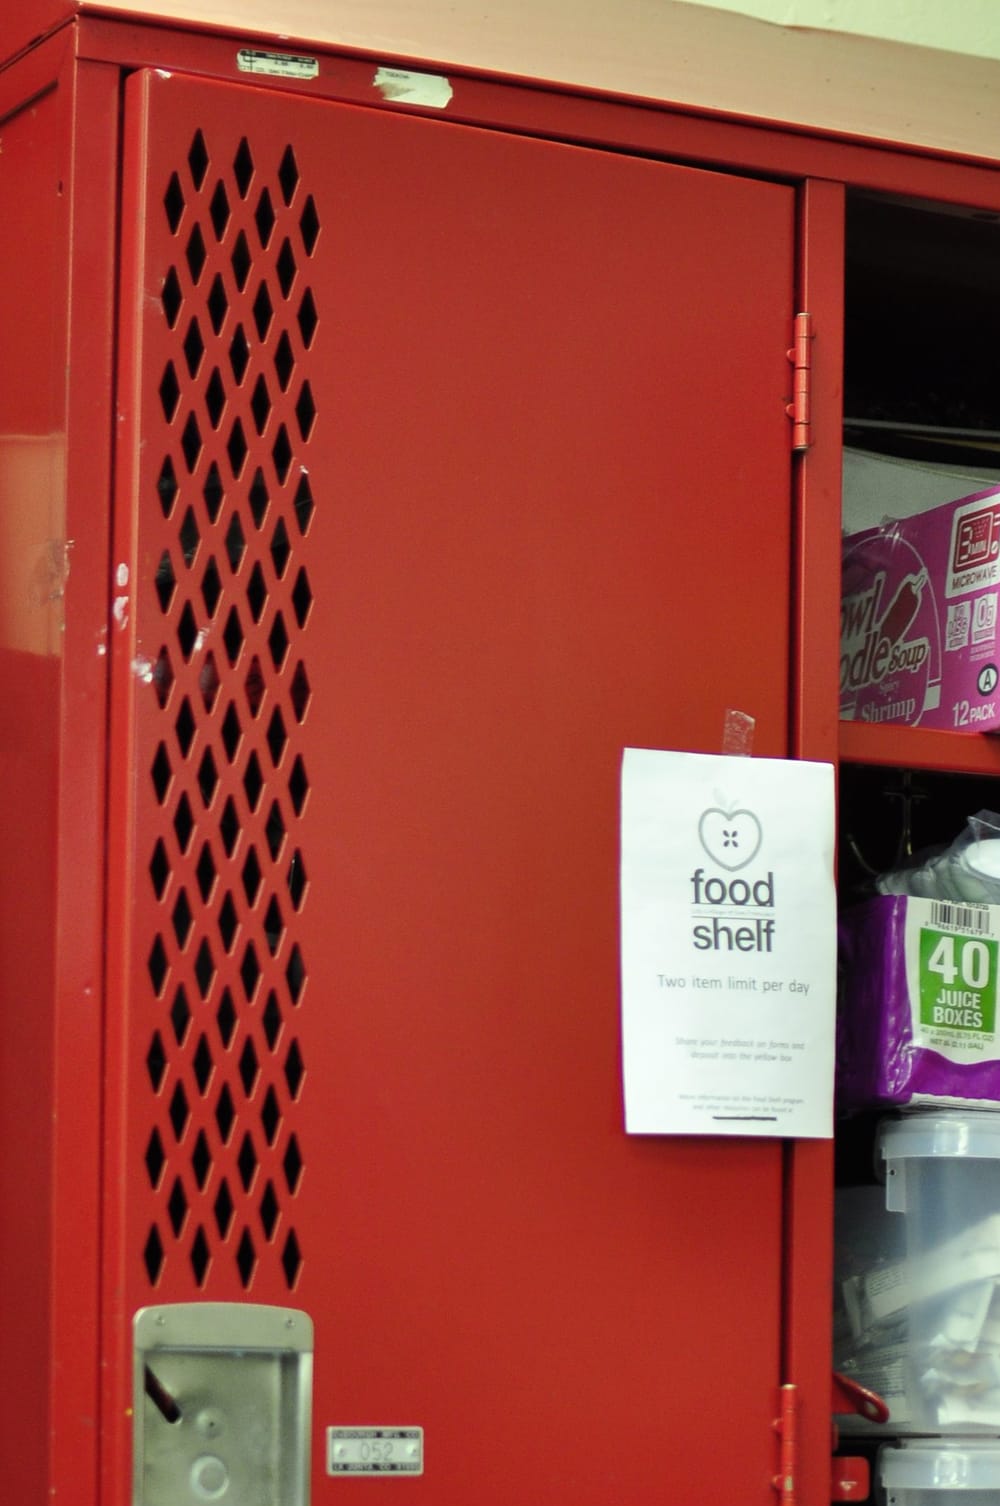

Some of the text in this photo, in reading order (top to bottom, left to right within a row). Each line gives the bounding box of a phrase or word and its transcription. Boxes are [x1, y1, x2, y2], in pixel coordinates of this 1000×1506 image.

[952, 565, 998, 590] MICROWAVE
[861, 696, 916, 723] Shrimp
[952, 700, 997, 726] 12 PACK
[690, 868, 775, 907] food
[693, 917, 776, 952] shelf
[928, 936, 990, 989] 40
[657, 974, 810, 996] Two item limit per day
[936, 989, 982, 1010] JUICE
[933, 1006, 983, 1028] BOXES
